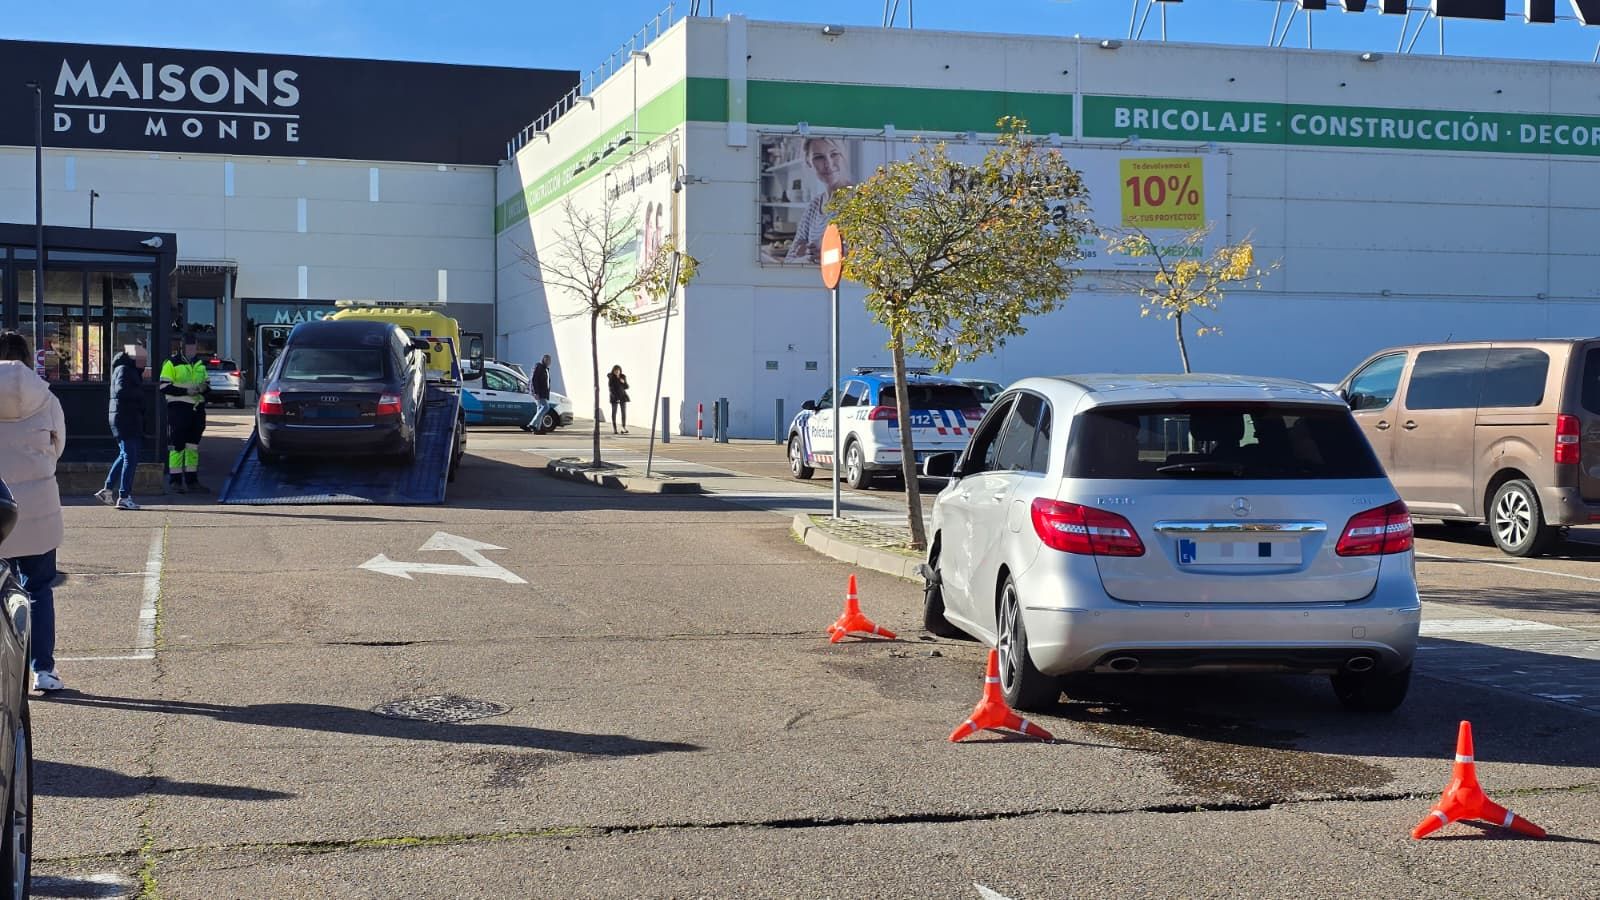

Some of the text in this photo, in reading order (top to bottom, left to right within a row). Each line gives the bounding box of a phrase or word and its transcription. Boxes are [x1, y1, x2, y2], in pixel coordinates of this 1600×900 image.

[54, 59, 300, 107] MAISONS
[53, 113, 300, 142] DU MONDE
[1114, 107, 1267, 133] BRICOLAJE
[1290, 115, 1498, 142] CONSTRUCCIÓN
[1141, 161, 1182, 170] devolvemos
[1125, 175, 1199, 207] 10%
[910, 415, 930, 425] 112
